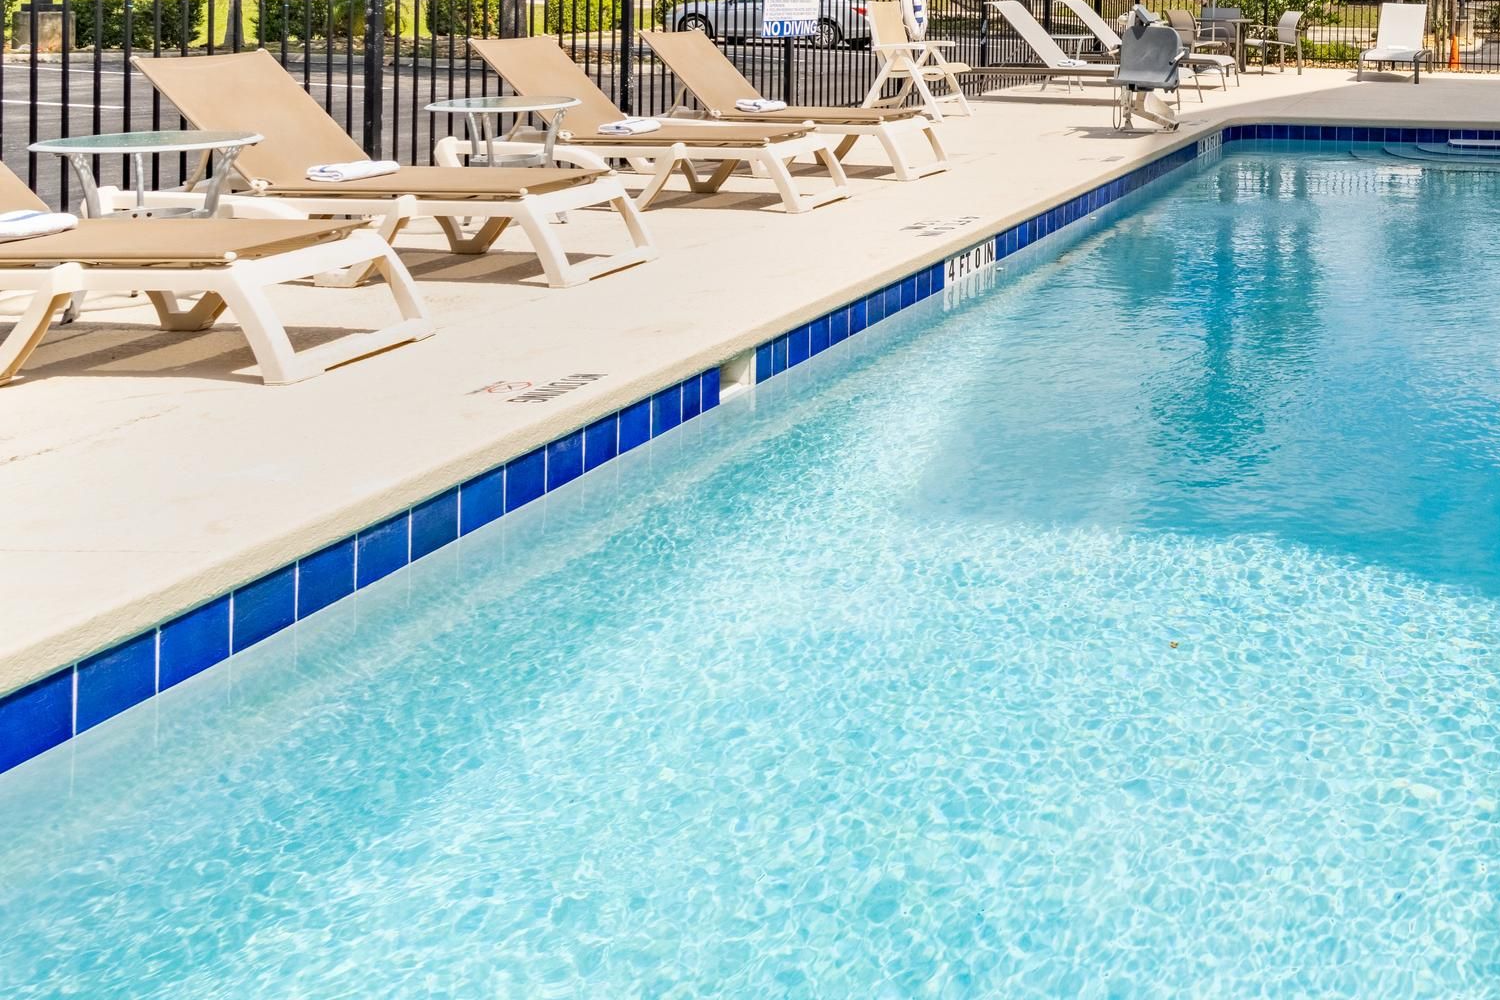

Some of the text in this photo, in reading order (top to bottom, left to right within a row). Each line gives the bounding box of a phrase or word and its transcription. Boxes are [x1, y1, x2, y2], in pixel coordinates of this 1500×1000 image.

[763, 20, 817, 37] NO DIVING
[948, 259, 955, 282] 4
